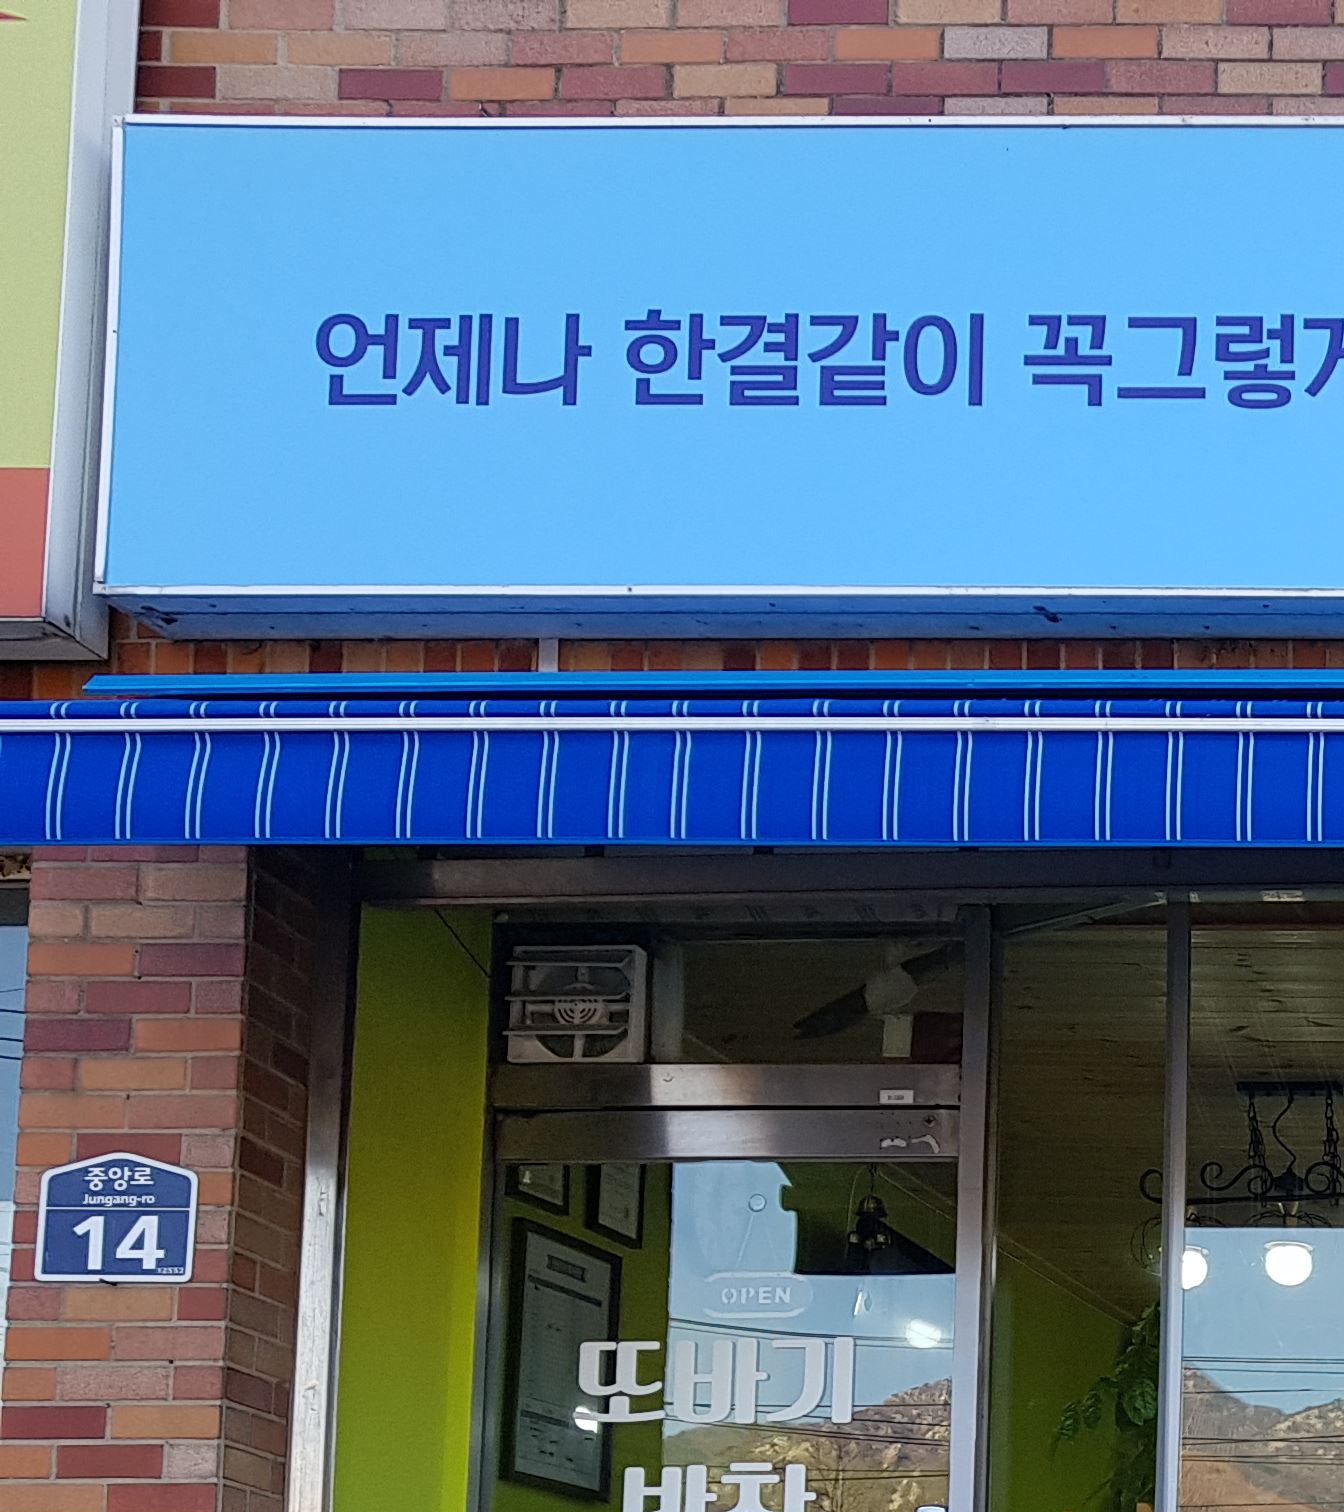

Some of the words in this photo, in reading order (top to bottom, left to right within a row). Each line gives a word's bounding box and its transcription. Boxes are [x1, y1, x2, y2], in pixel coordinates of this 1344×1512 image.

[314, 312, 592, 407] 언제나
[623, 308, 985, 407] 한결같이
[84, 1166, 154, 1191] 중앙로
[82, 1193, 155, 1207] Jungang-ro
[72, 1215, 165, 1271] 14
[720, 1286, 792, 1305] OPEN
[573, 1336, 854, 1425] 또바기
